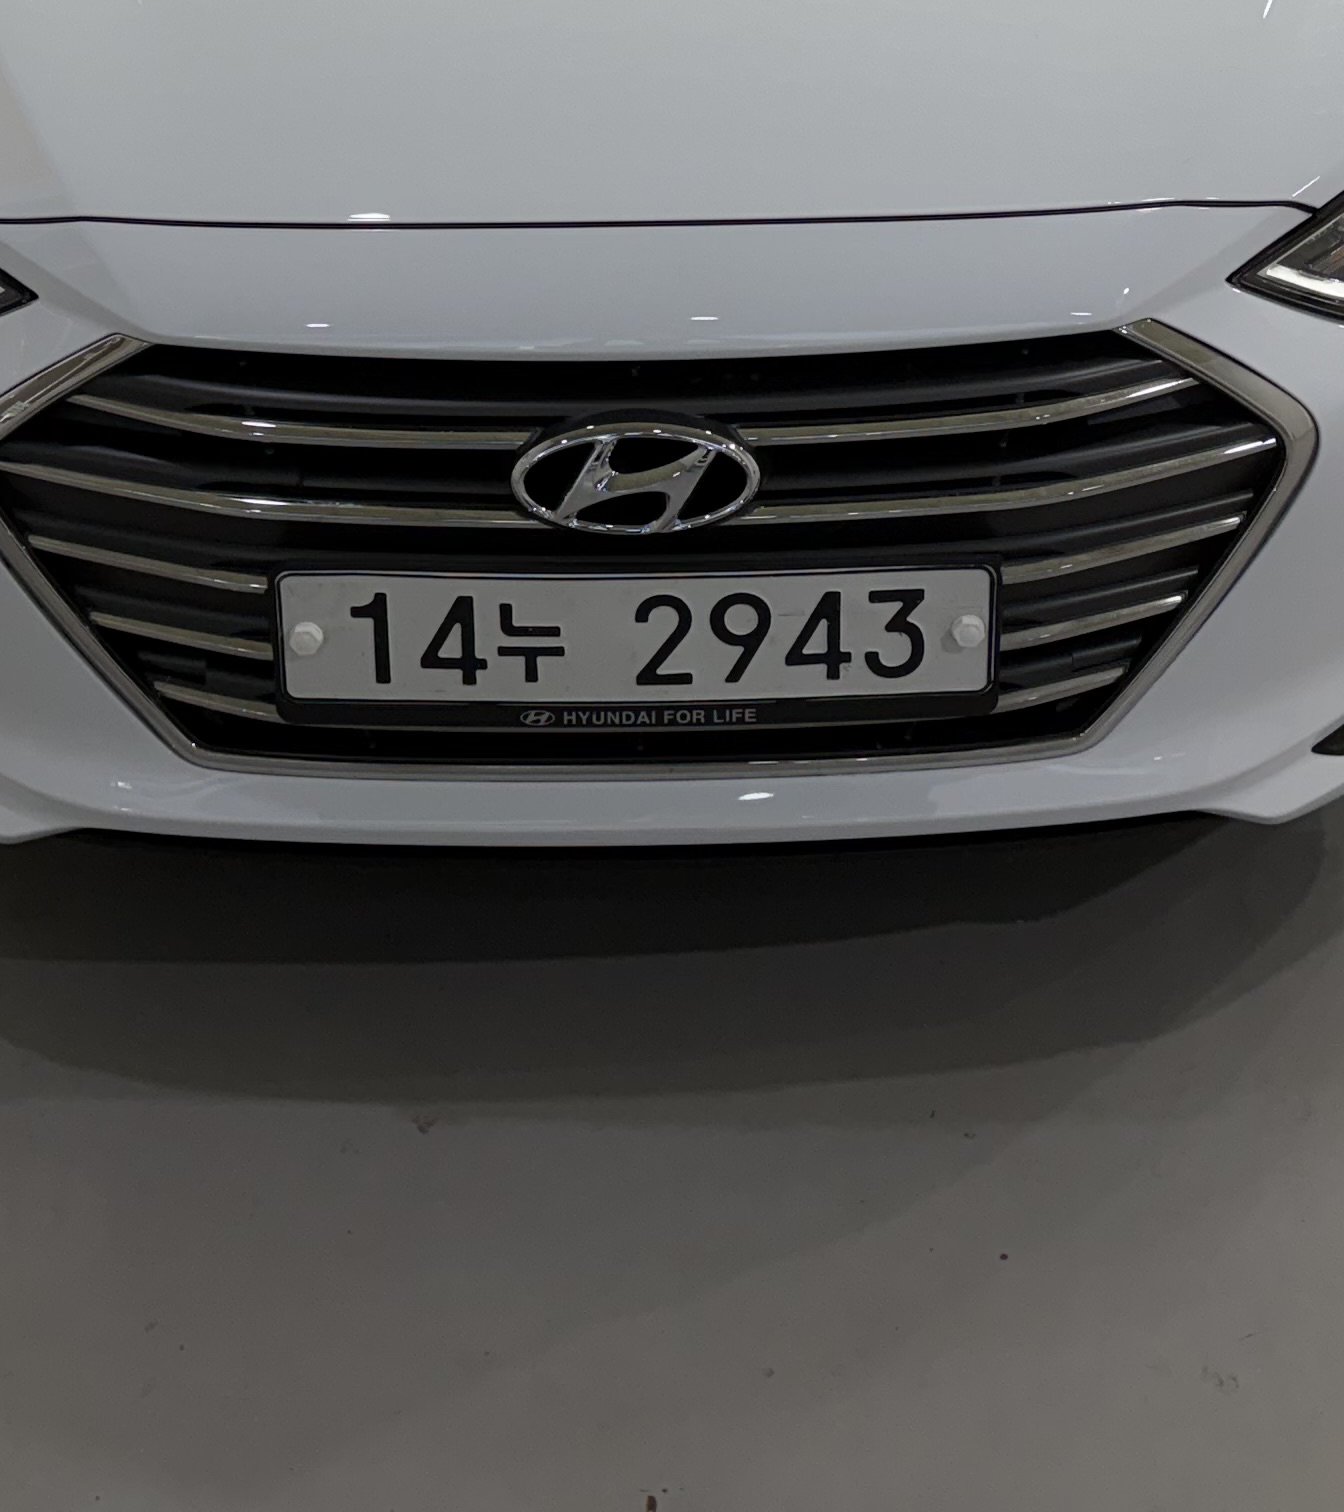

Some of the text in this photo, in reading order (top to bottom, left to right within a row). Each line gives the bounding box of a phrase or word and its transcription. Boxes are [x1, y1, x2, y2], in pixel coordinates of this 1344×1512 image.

[349, 588, 926, 686] 14누 2943
[562, 707, 757, 726] HYUNDAI FOR LIFE
